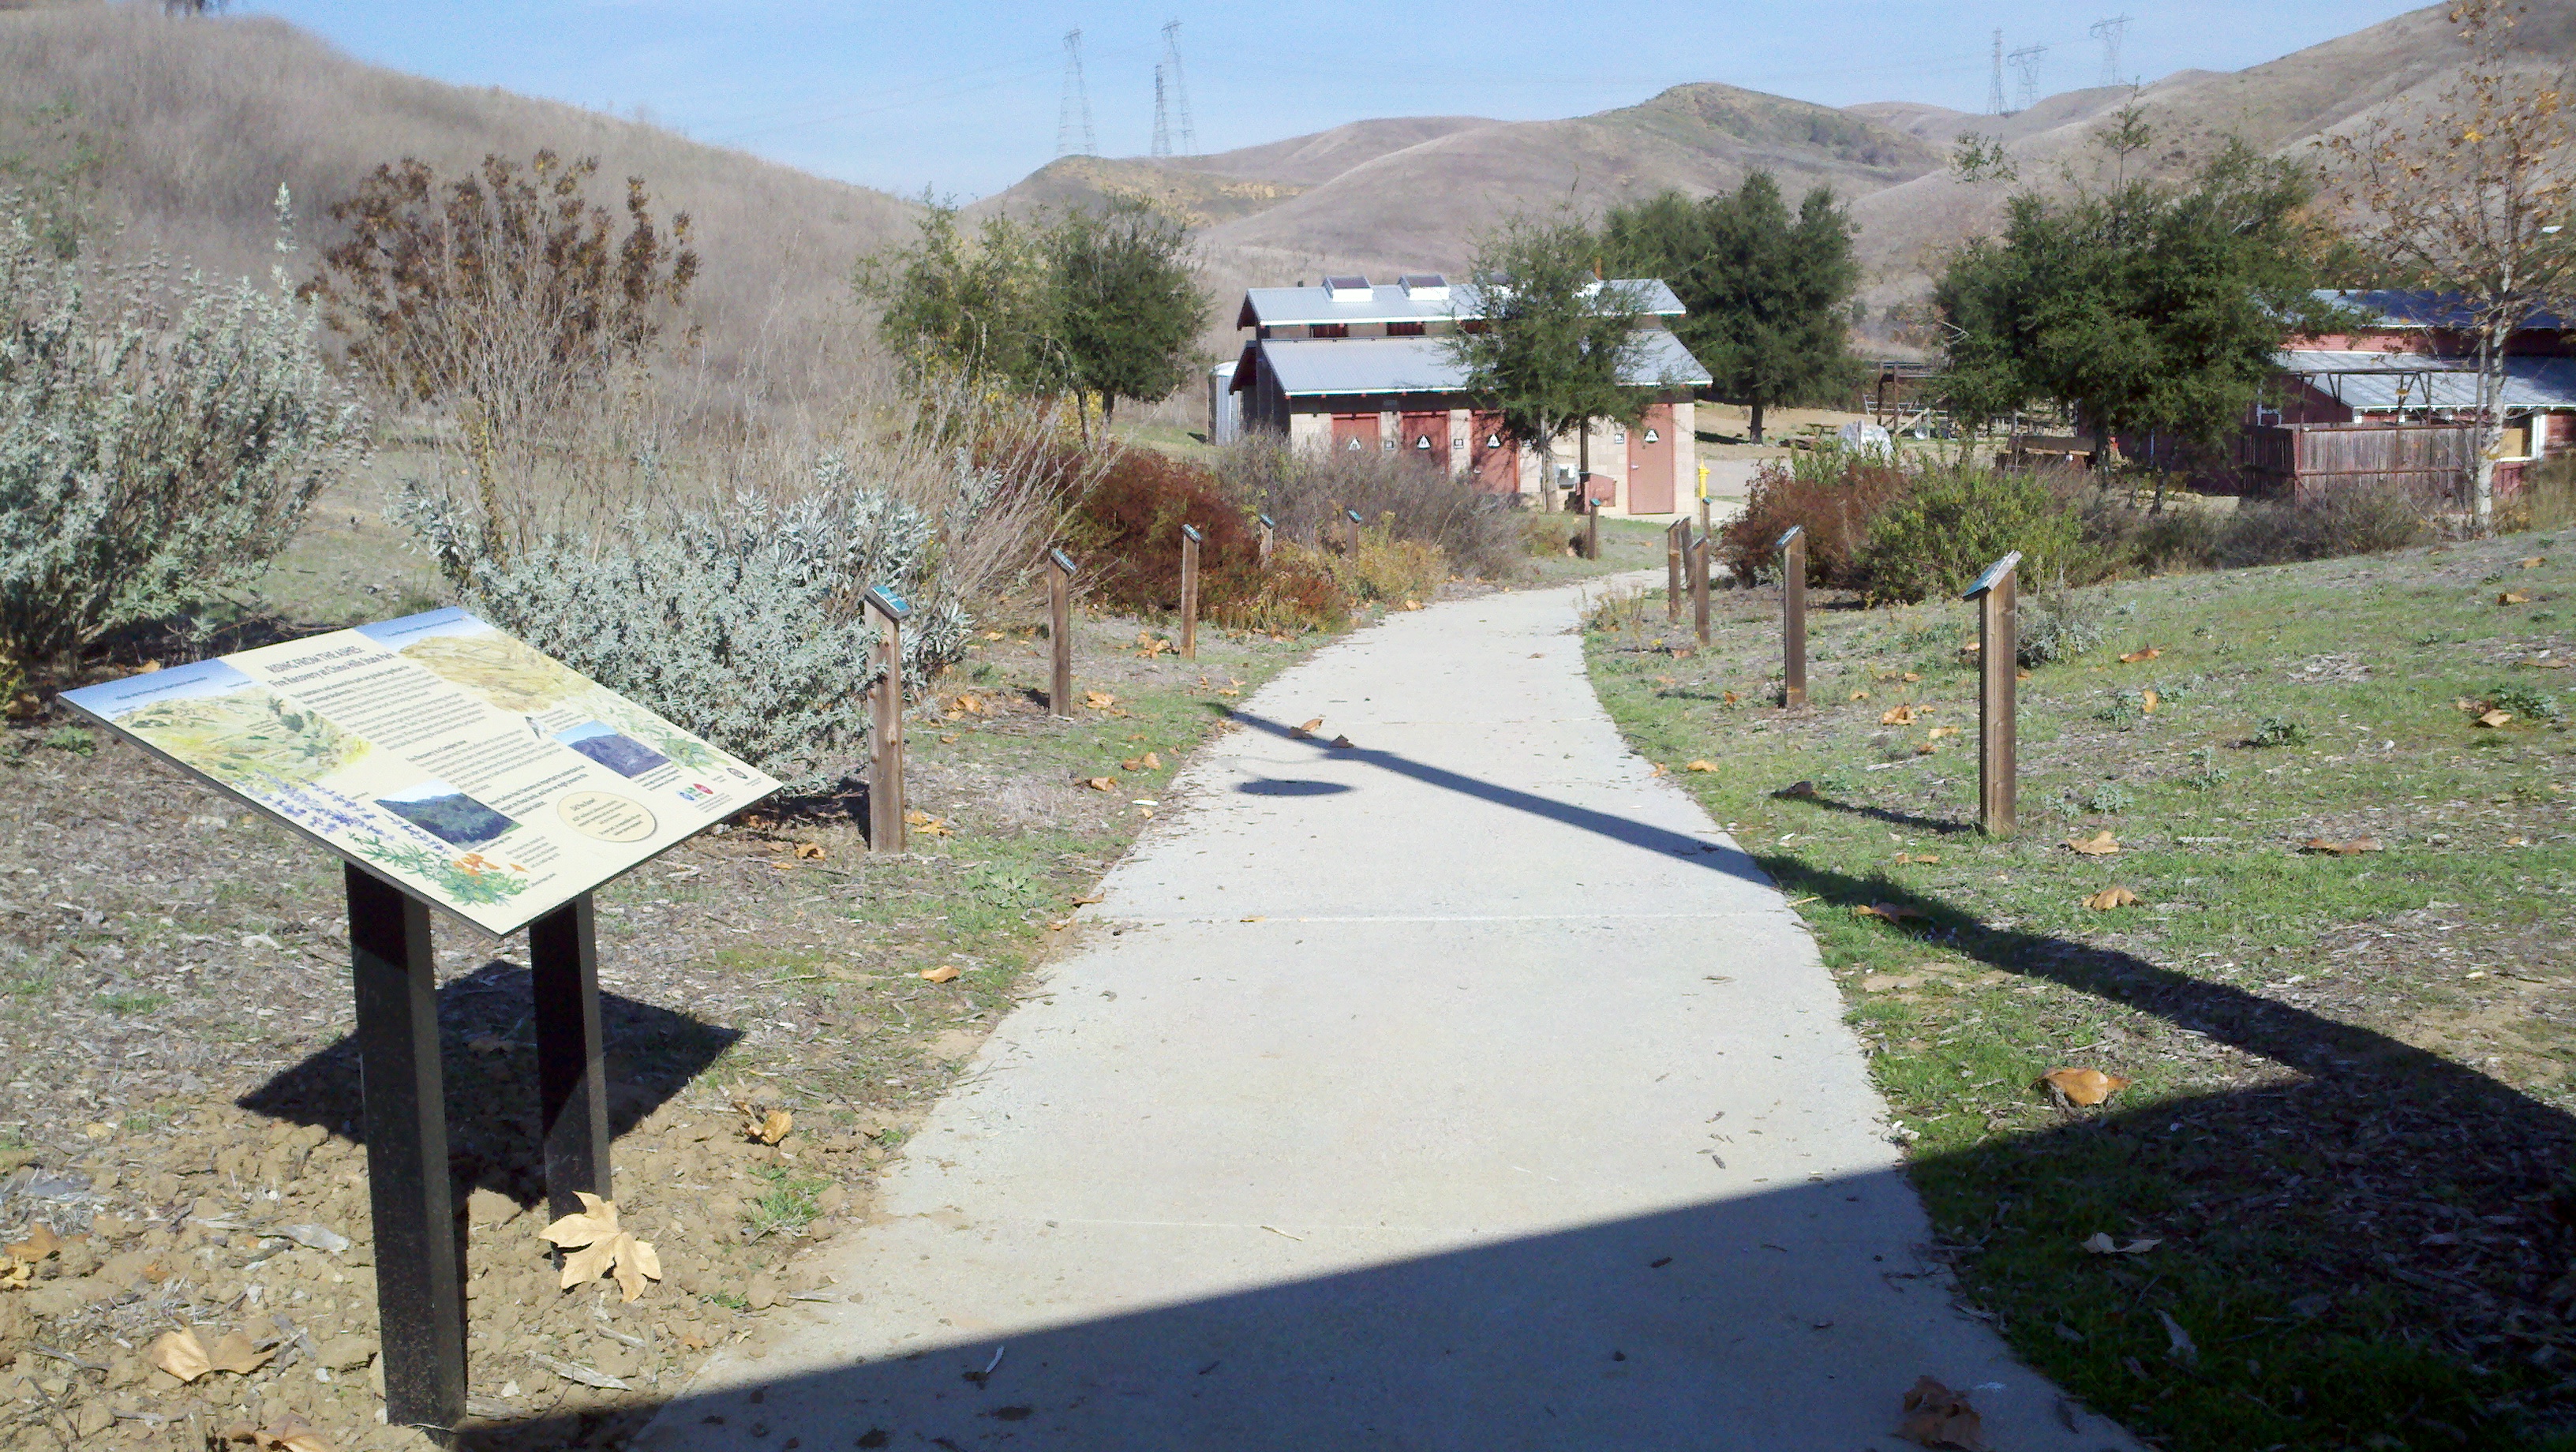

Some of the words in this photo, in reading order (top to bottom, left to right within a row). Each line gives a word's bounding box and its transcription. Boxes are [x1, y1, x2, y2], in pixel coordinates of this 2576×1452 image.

[265, 661, 299, 673] RISING
[292, 656, 321, 666] FROM
[316, 651, 339, 660] THE
[283, 672, 323, 683] Recovery
[324, 664, 350, 673] Chino
[345, 659, 365, 668] Hills
